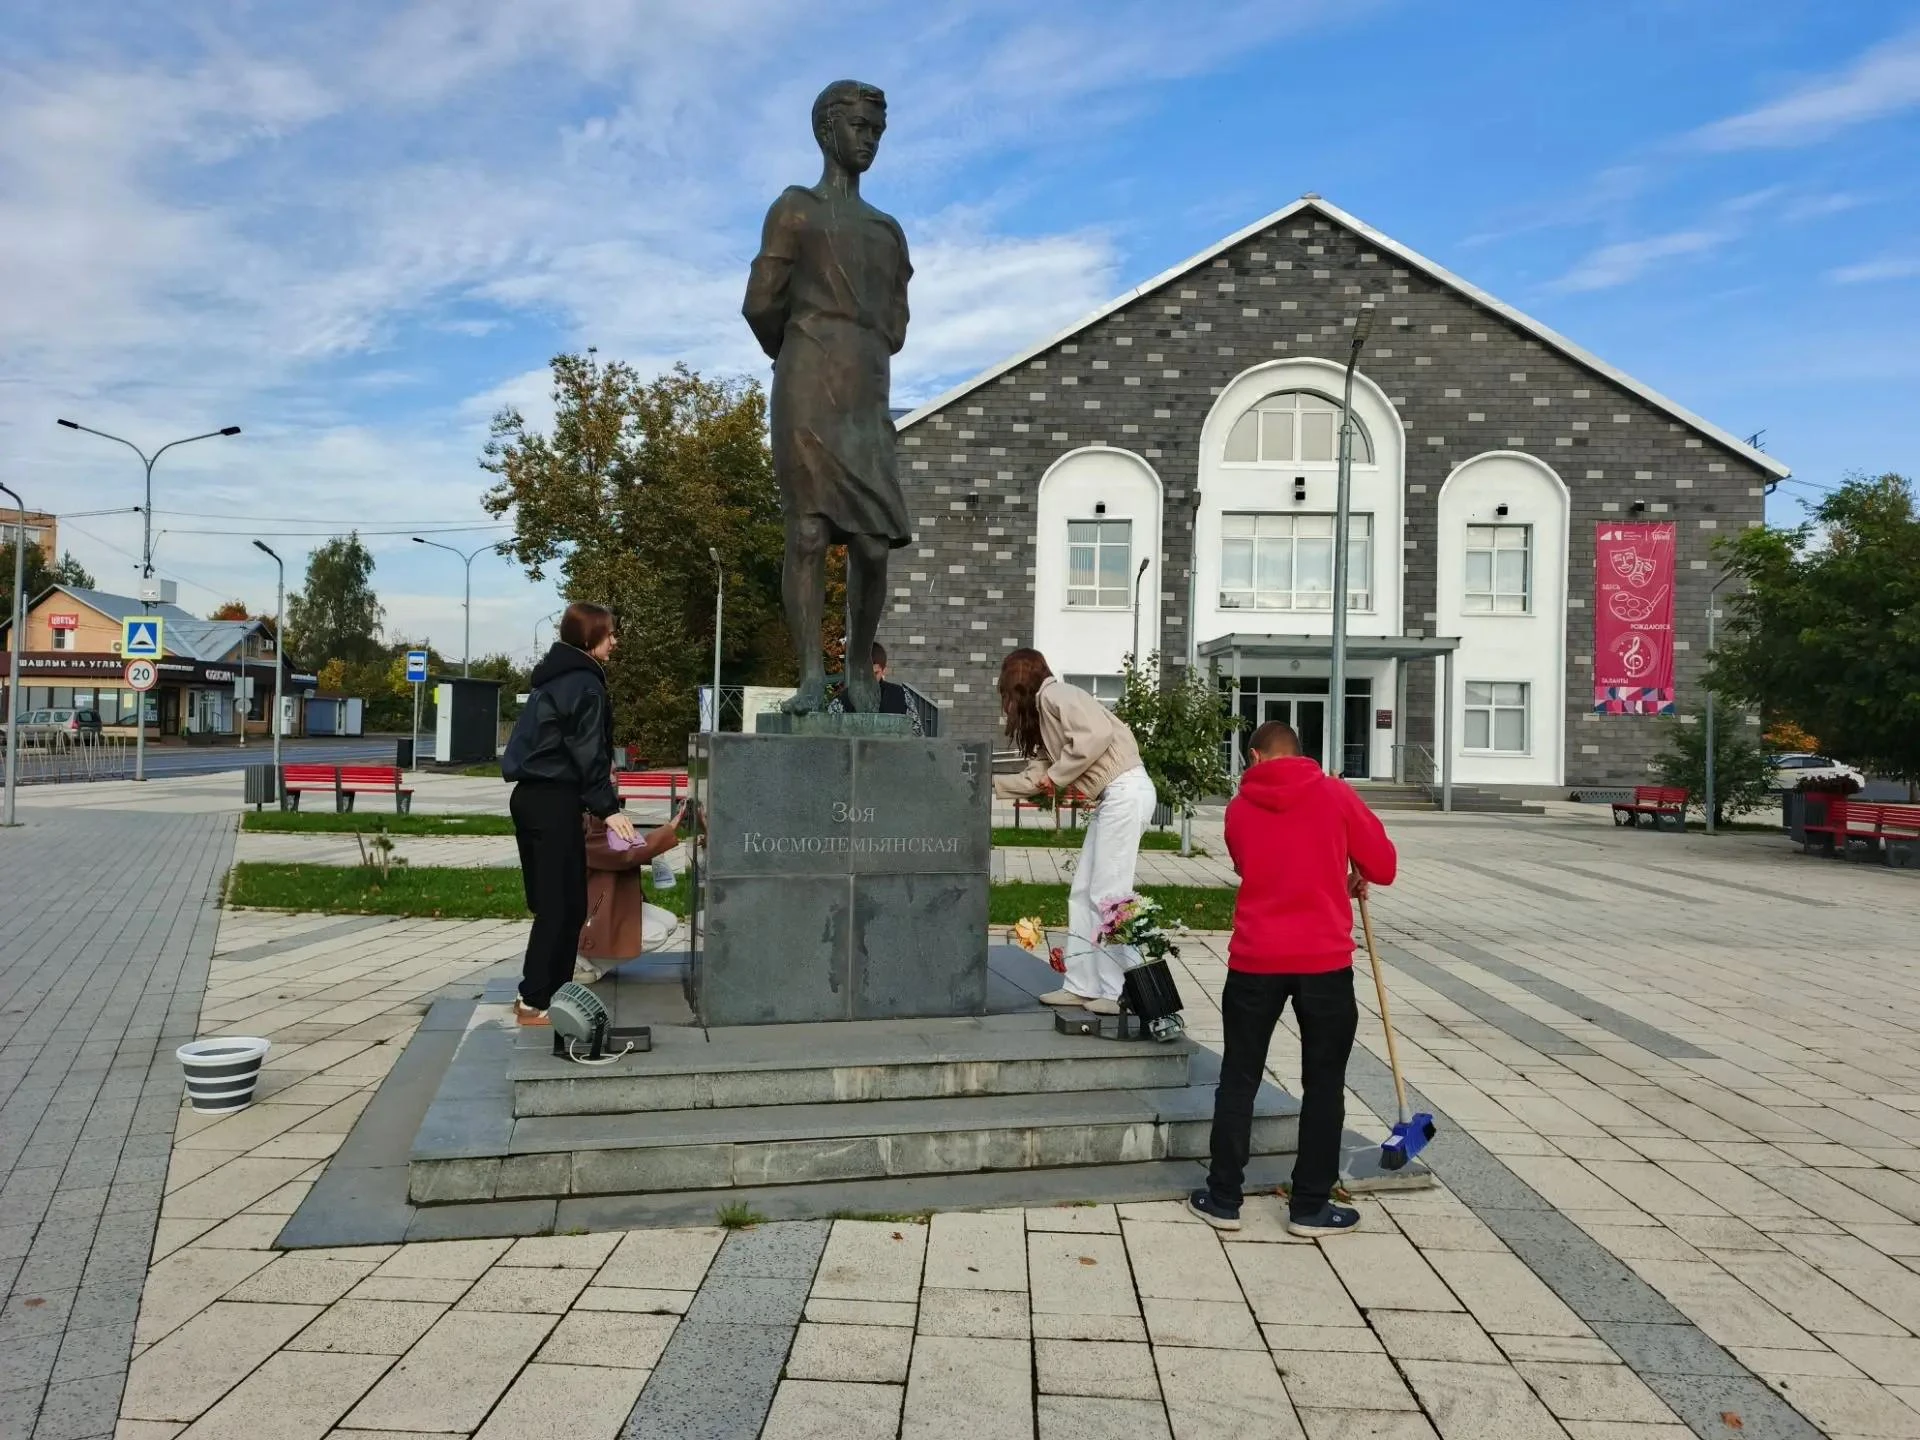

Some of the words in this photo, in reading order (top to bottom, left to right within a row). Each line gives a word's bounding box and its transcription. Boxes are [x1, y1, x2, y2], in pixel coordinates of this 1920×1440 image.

[51, 615, 76, 625] ЦВЕТЫ
[19, 659, 67, 668] ШАШЛЫК
[71, 659, 88, 668] НА
[90, 660, 122, 669] УГЛЯХ
[132, 668, 150, 681] 20
